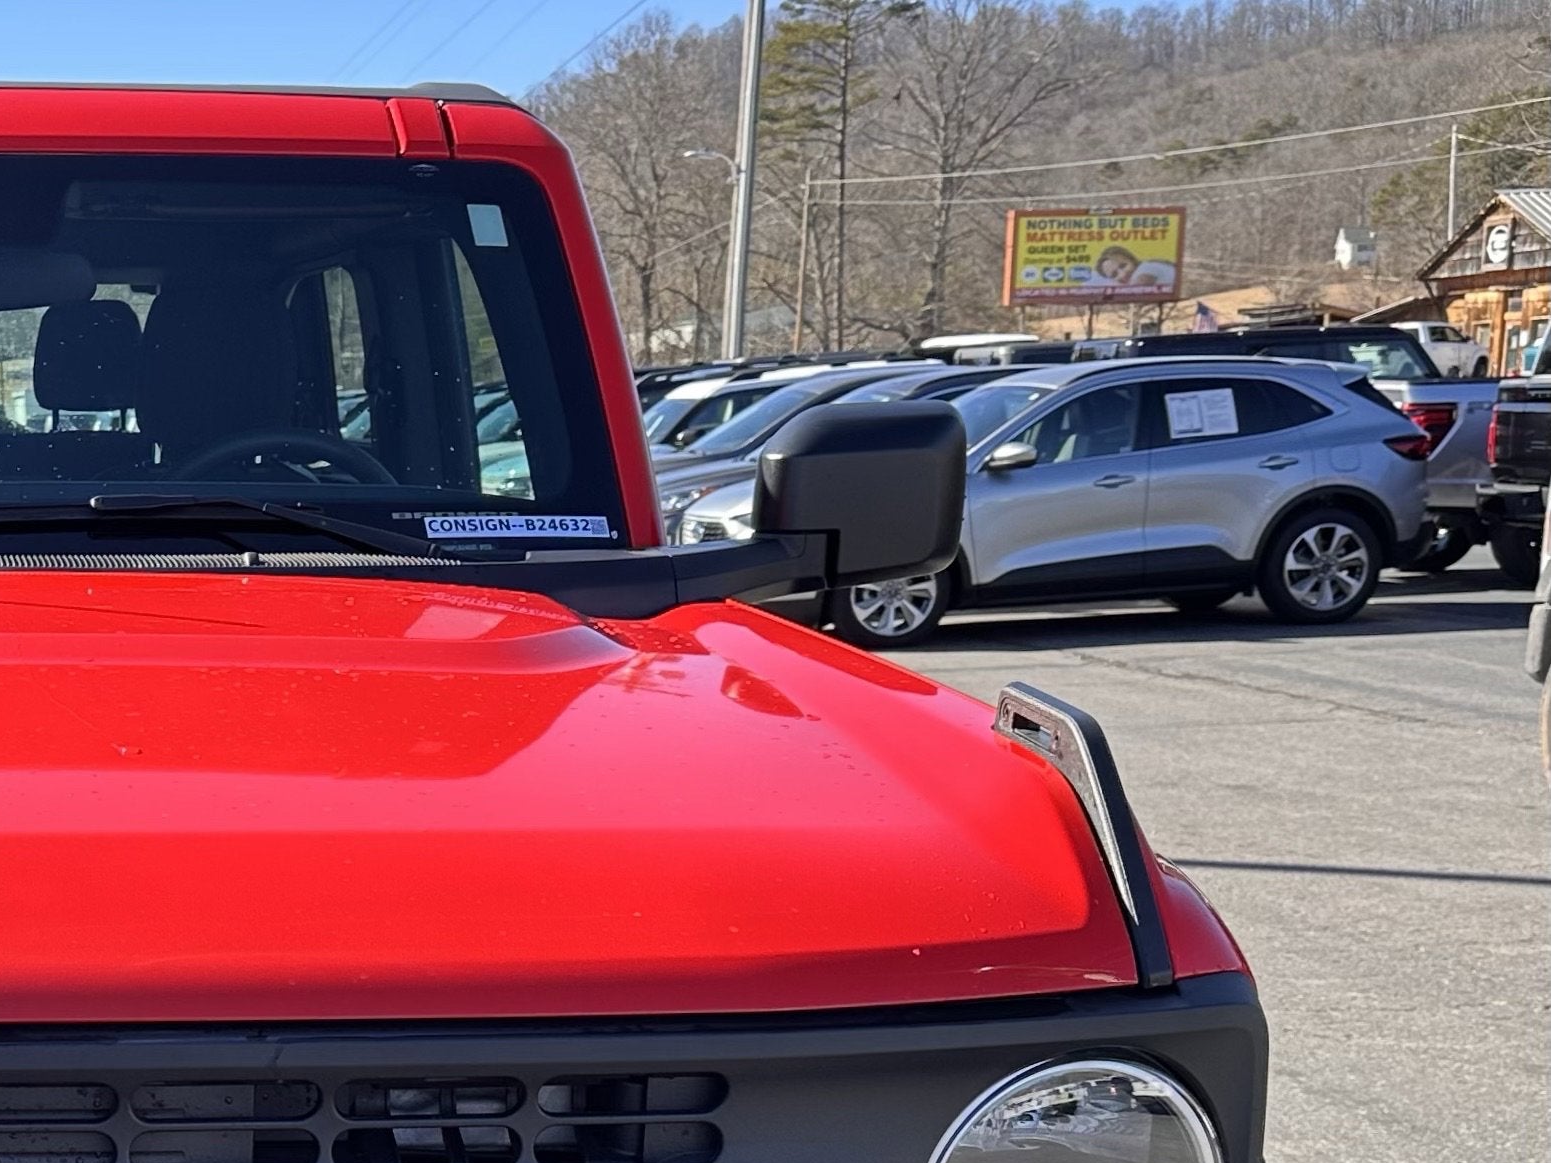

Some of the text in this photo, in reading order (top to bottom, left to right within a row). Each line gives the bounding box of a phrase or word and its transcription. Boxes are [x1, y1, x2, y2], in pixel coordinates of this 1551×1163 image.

[1026, 217, 1170, 230] NOTHING BUT BEDS
[1026, 229, 1168, 242] MATTRESS OUTLET
[1028, 244, 1087, 254] QUEEN SET
[428, 518, 591, 532] CONSIGN--B24632
